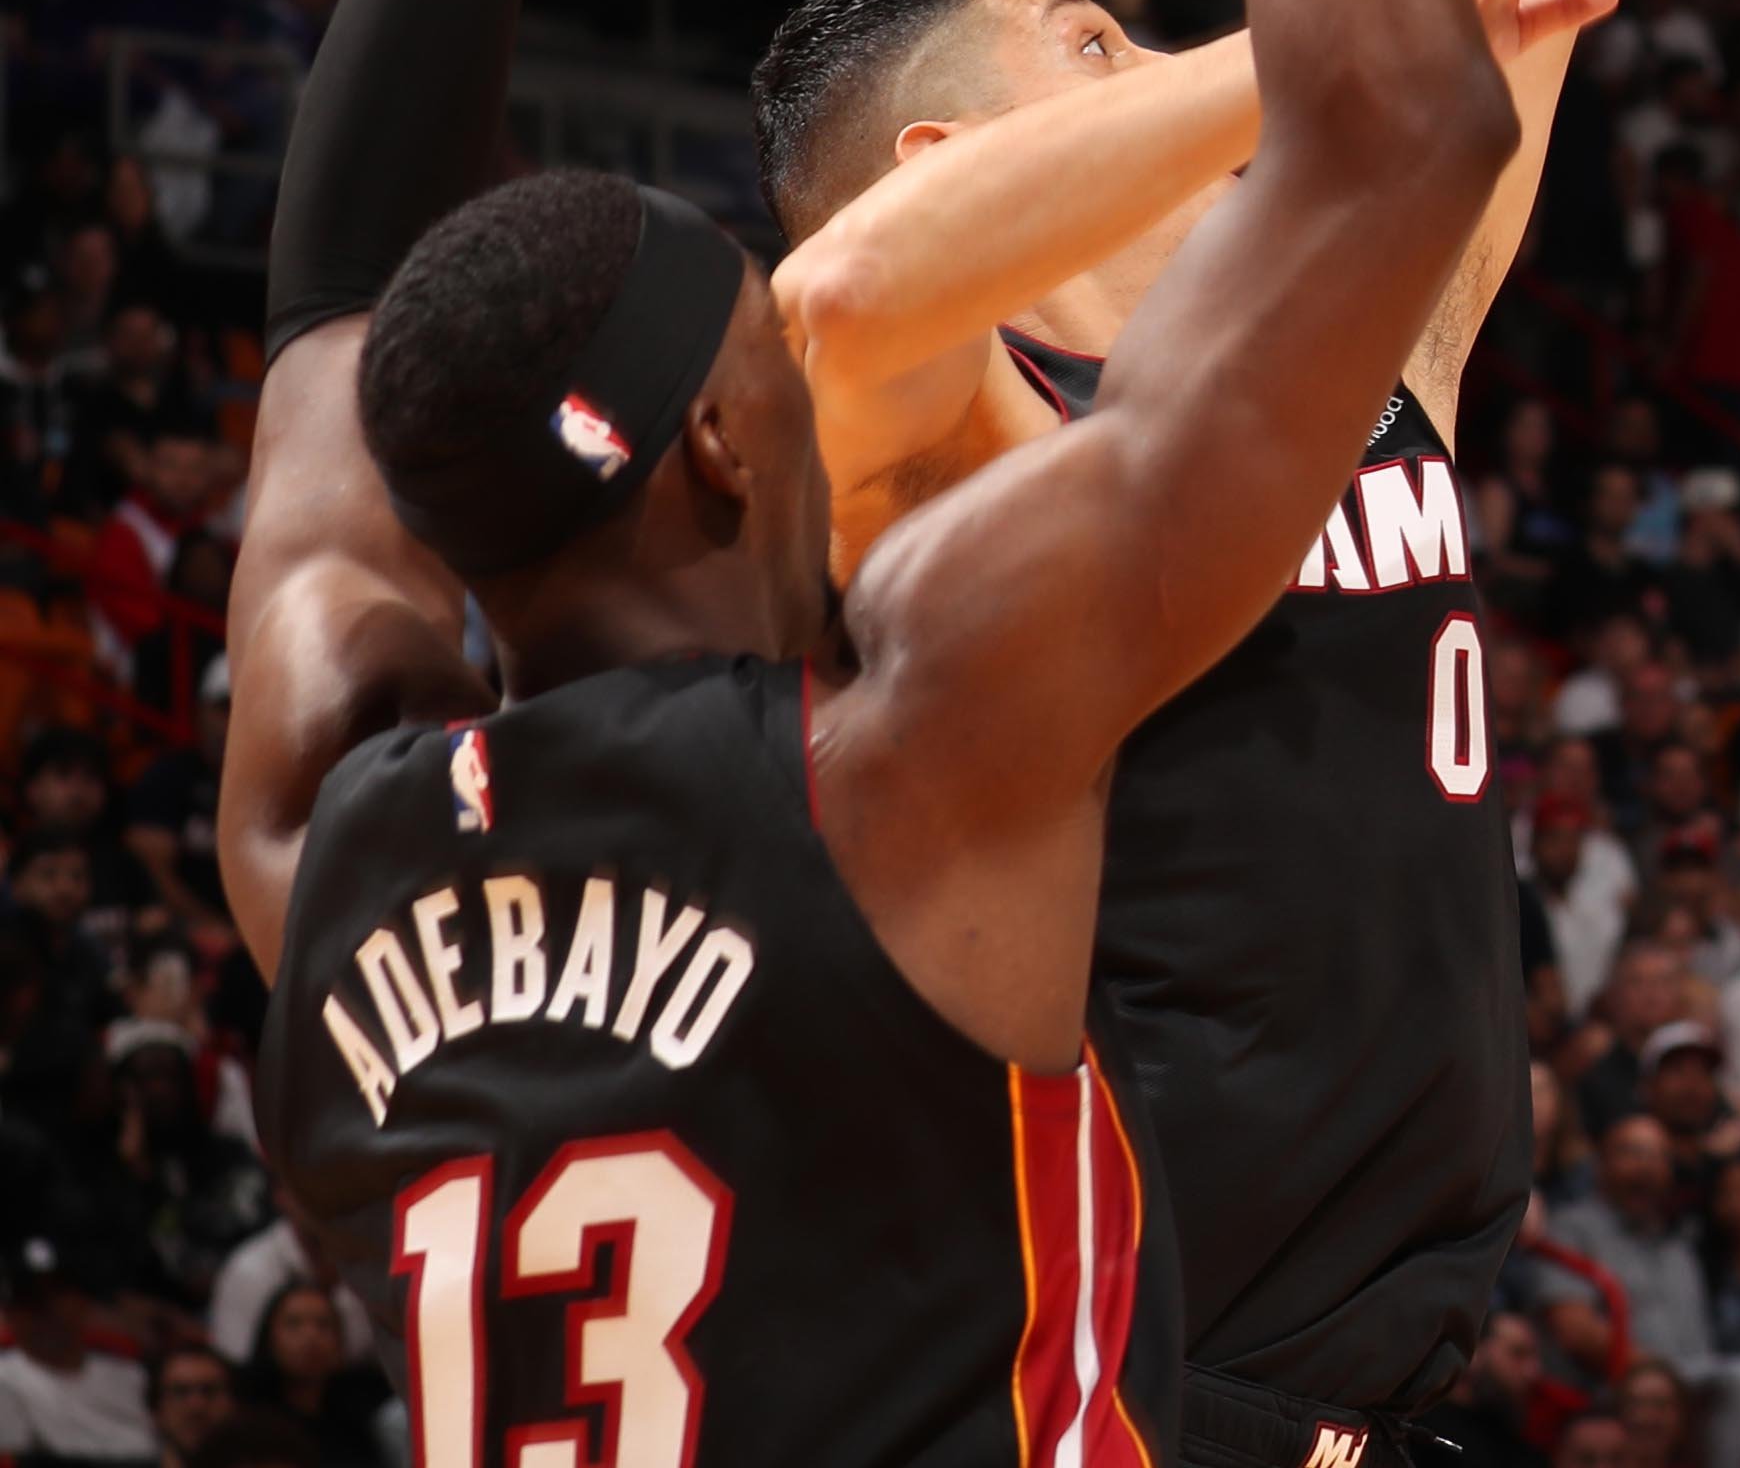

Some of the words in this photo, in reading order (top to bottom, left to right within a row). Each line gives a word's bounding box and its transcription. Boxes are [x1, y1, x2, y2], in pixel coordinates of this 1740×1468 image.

[1425, 609, 1493, 804] 0
[322, 874, 755, 1130] ADEBAYO
[390, 1128, 736, 1468] 13
